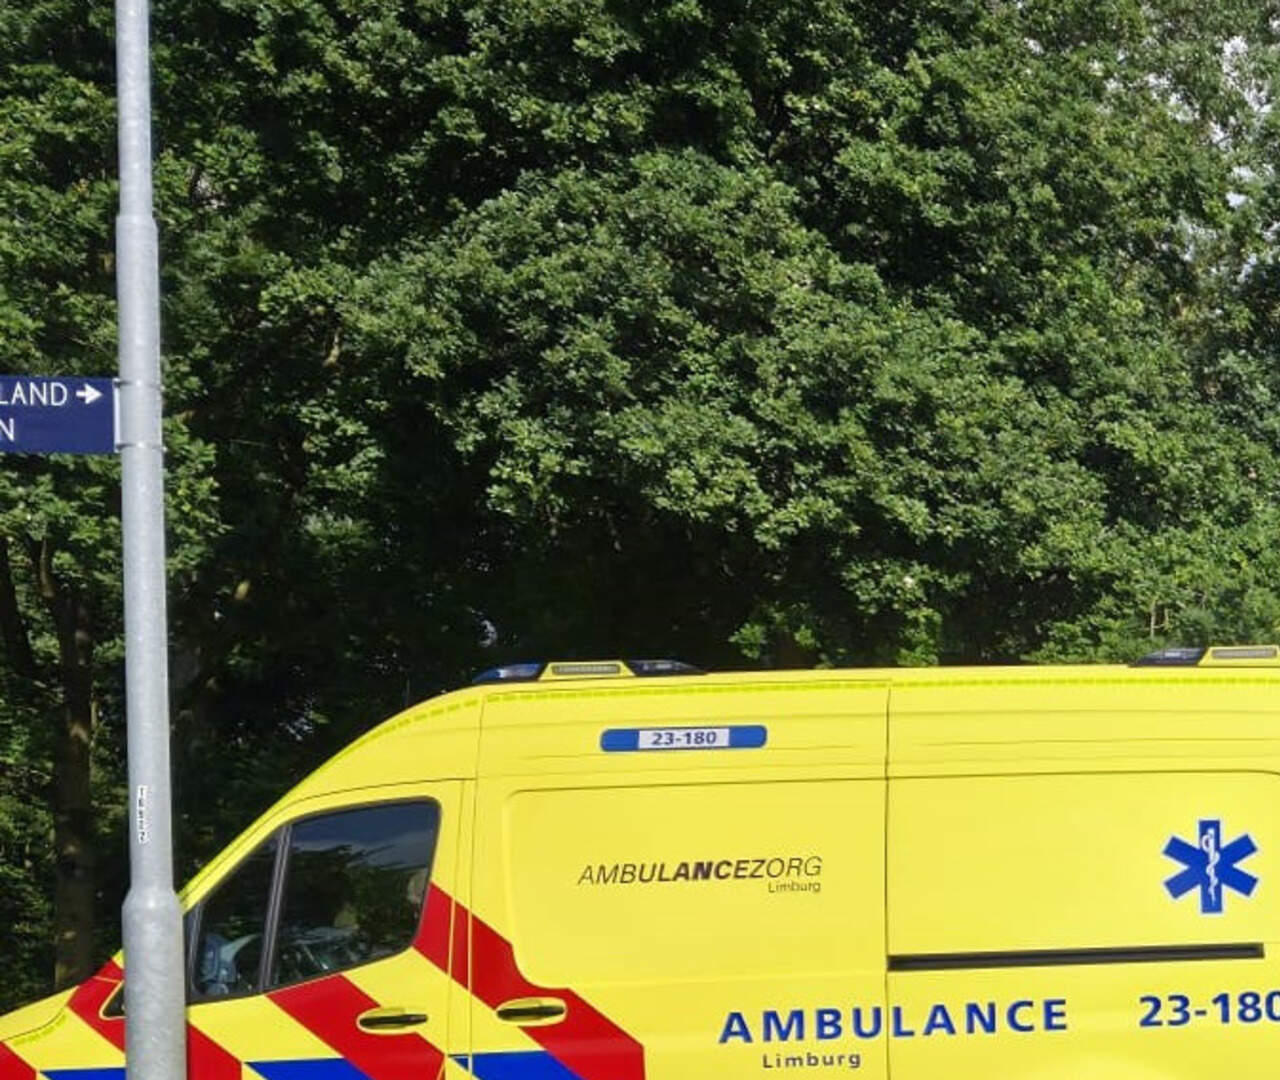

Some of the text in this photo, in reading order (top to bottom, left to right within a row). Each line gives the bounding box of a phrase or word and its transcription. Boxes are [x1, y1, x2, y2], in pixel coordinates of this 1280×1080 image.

[651, 731, 717, 746] 23-180
[577, 856, 823, 886] AMBULANCEZORG
[767, 881, 822, 894] Limburg
[718, 999, 1067, 1044] AMBULANCE
[762, 1052, 862, 1069] Limburg
